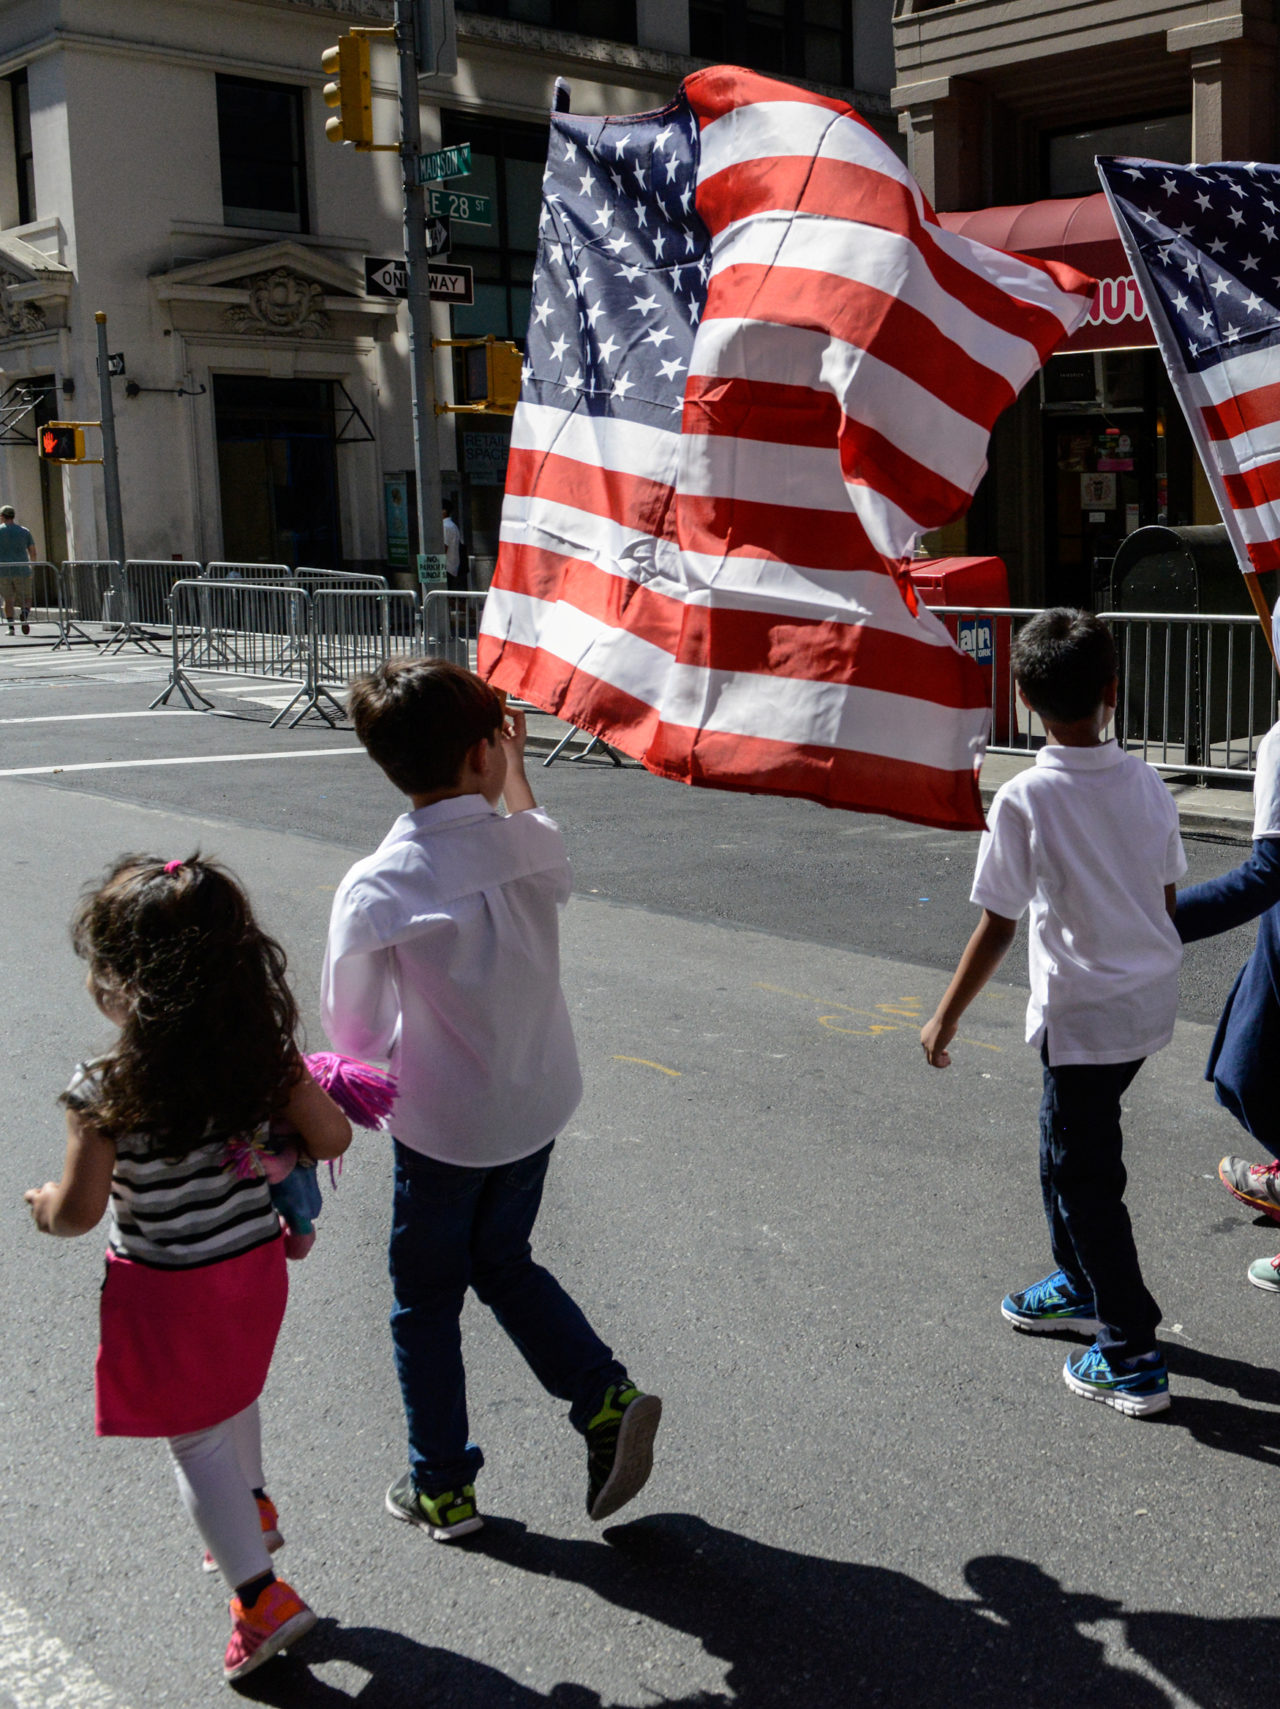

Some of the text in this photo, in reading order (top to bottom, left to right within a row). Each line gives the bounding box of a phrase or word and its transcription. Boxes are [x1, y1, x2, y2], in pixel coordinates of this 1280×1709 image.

[420, 151, 458, 180] MADISON
[431, 192, 485, 218] E 28 ST
[428, 275, 459, 292] WAY
[465, 434, 508, 447] RETAIL
[466, 447, 509, 460] SPACE
